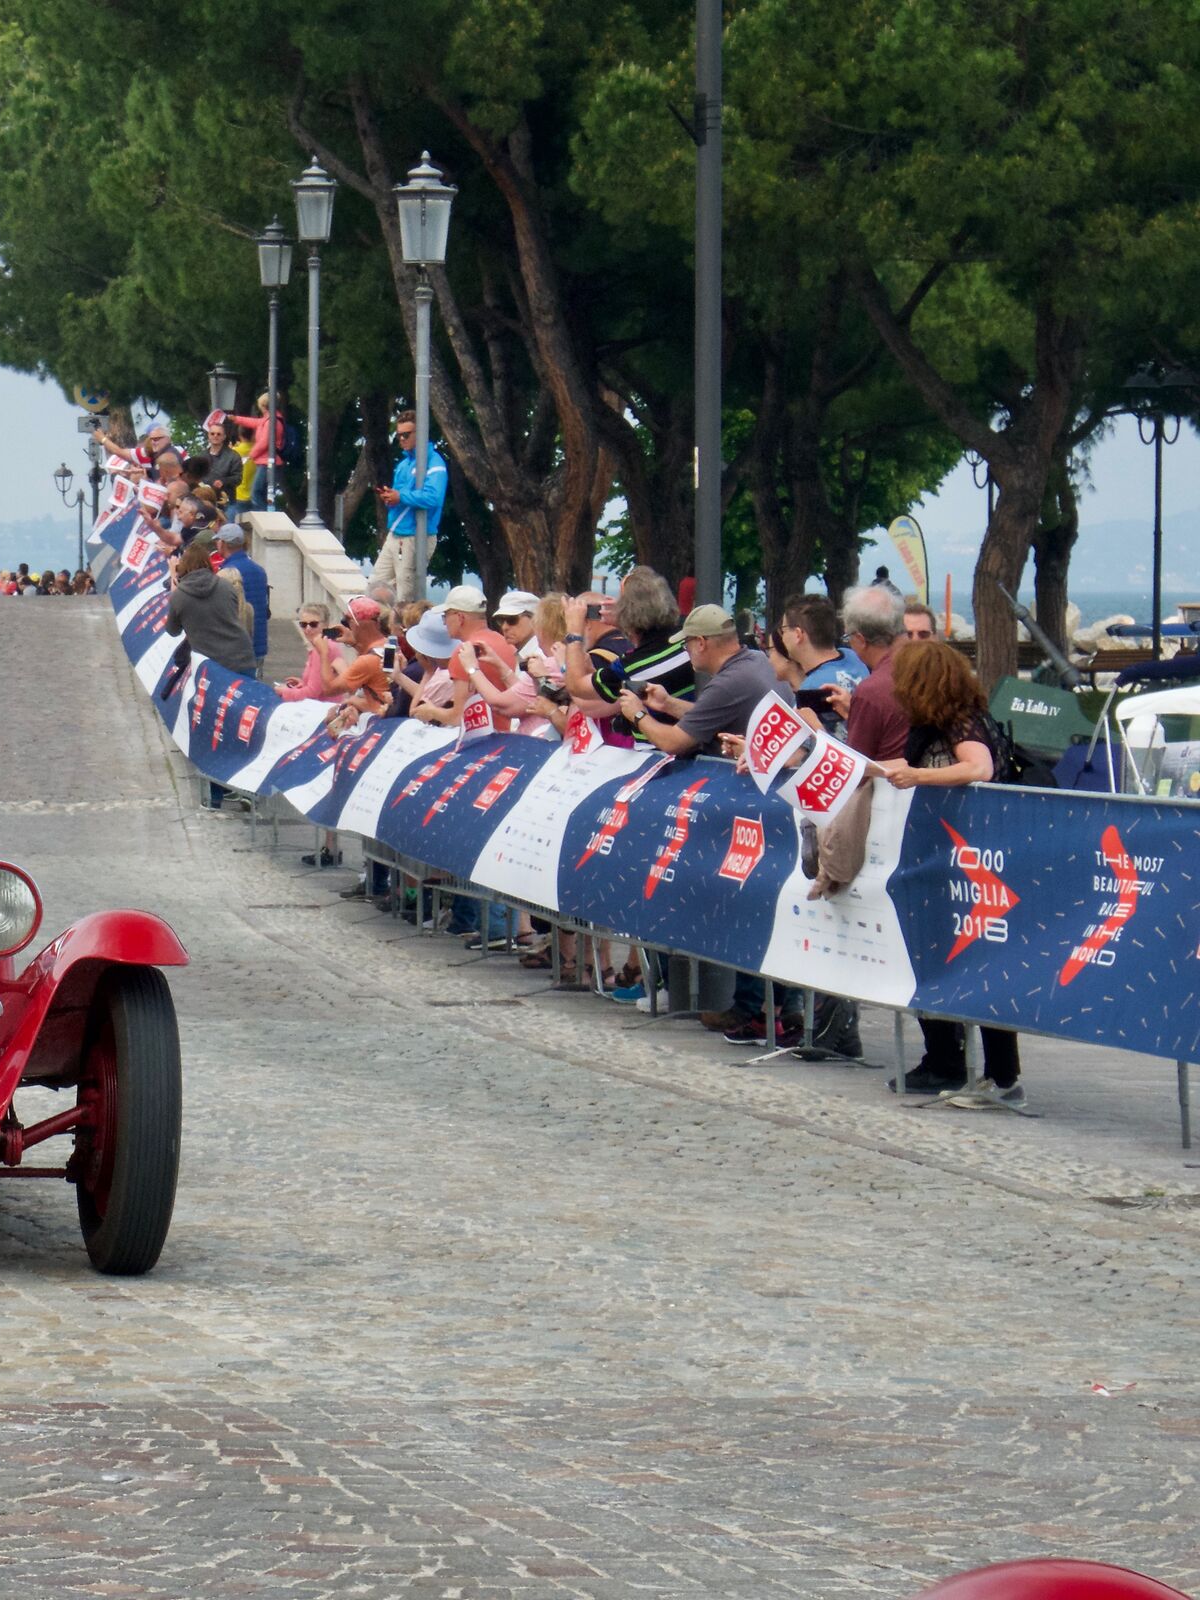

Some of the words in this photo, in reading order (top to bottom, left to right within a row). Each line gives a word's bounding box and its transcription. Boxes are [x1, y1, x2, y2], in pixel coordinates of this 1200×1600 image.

[465, 716, 490, 731] GLIA
[751, 710, 781, 752] 1000
[759, 720, 798, 768] MIGLIA
[806, 749, 839, 793] 1000
[818, 756, 854, 807] MIGLIA
[597, 807, 628, 829] MIGLIA
[586, 831, 615, 855] 2018
[736, 825, 759, 848] 1000
[950, 846, 1004, 873] 1000
[1095, 850, 1130, 869] THE
[1133, 855, 1165, 873] MOST
[949, 879, 1010, 908] MIGLIA
[1093, 875, 1155, 896] BEAUTIFUL
[1097, 902, 1132, 918] RACE
[952, 912, 1009, 943] 2018
[1082, 924, 1097, 938] IN
[1094, 925, 1124, 942] THE
[1070, 945, 1116, 967] WORLD
